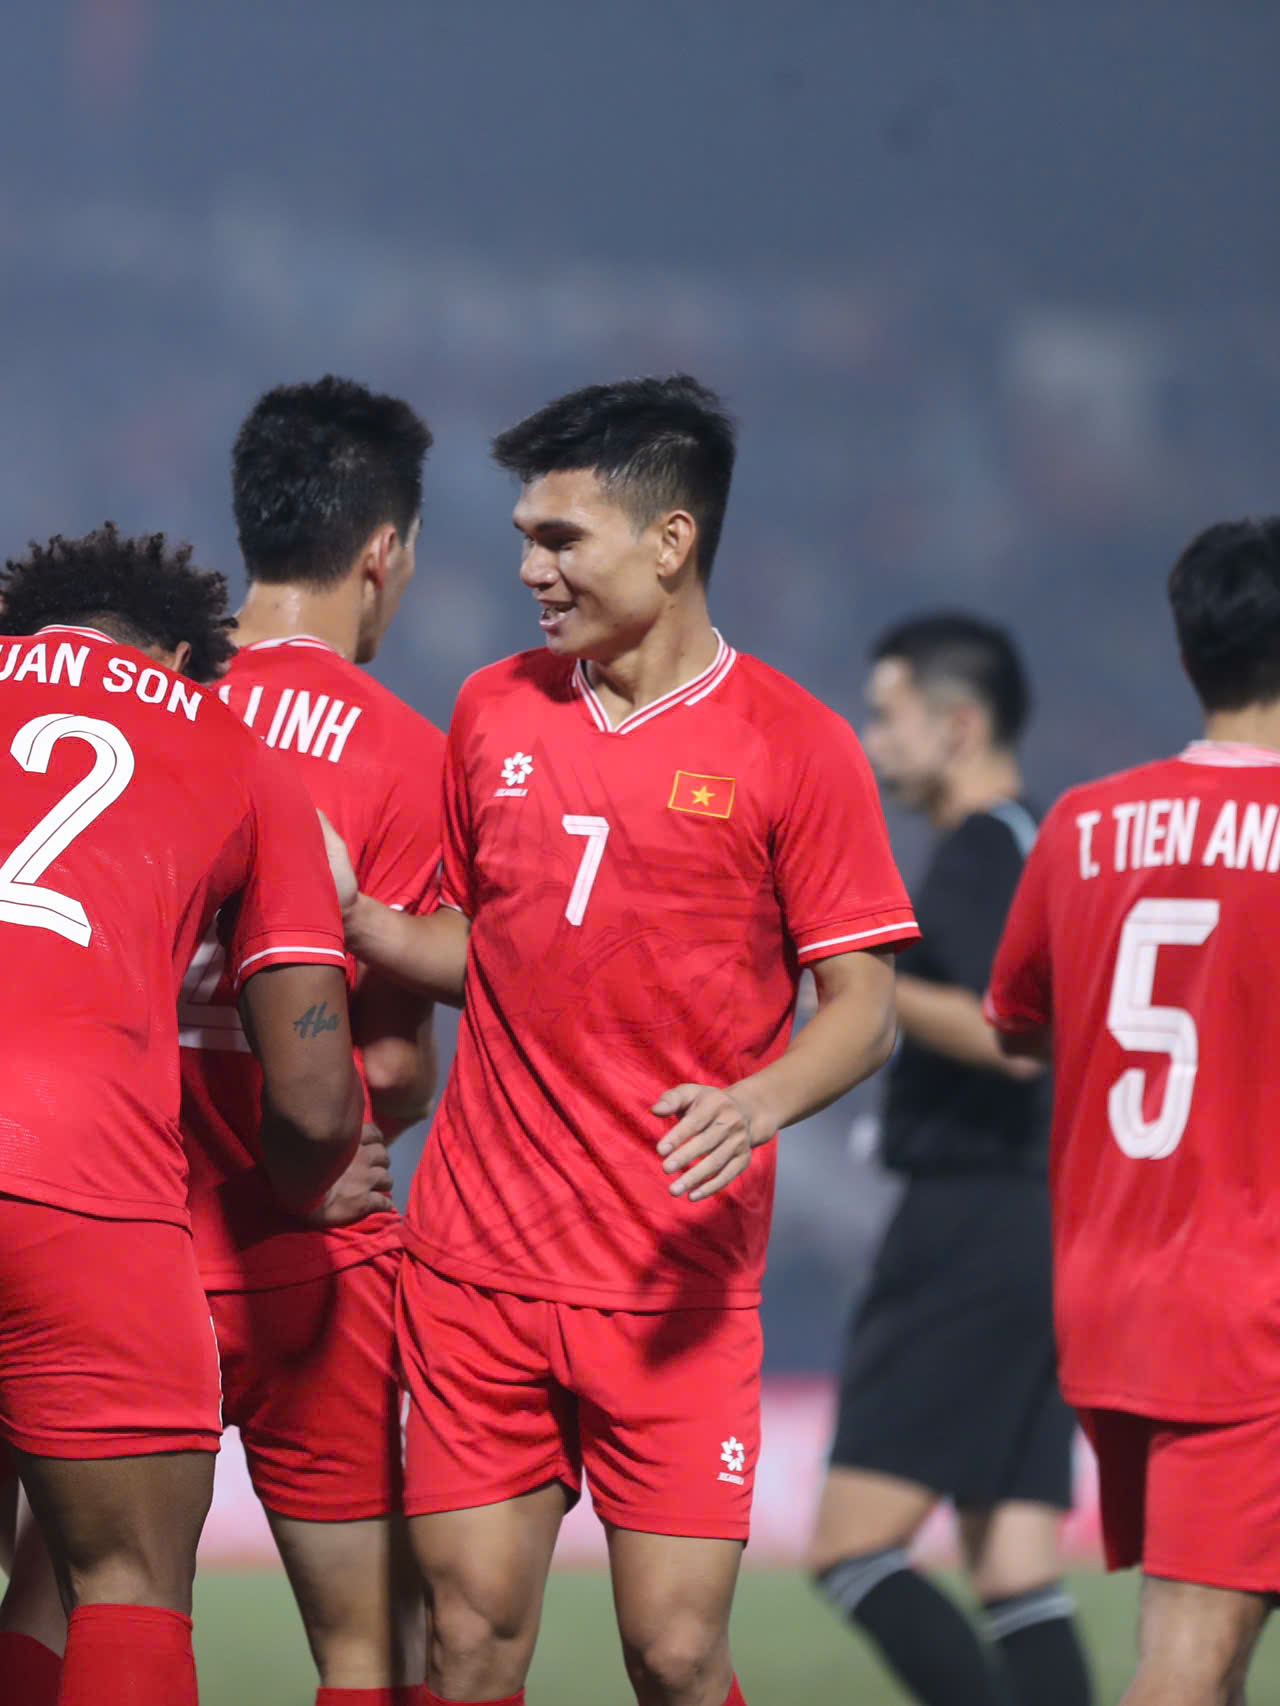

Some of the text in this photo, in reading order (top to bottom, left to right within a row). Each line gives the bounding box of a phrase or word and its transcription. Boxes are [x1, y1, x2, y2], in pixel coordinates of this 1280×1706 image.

[102, 657, 203, 722] SON
[562, 814, 610, 926] 7
[1075, 796, 1280, 881] T. TIEN AN
[1107, 898, 1220, 1161] 5
